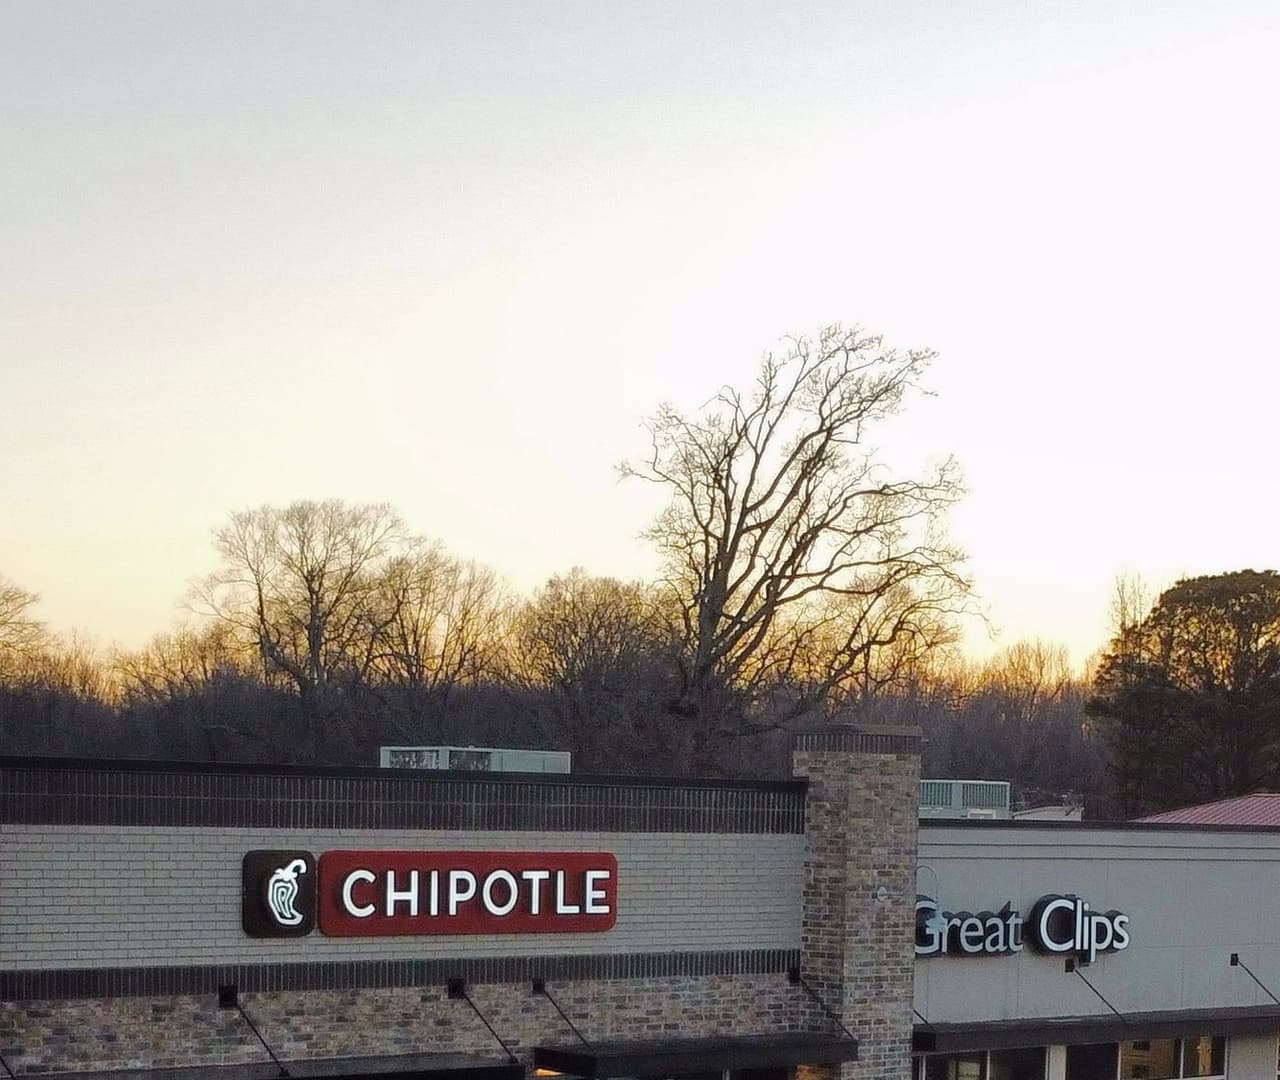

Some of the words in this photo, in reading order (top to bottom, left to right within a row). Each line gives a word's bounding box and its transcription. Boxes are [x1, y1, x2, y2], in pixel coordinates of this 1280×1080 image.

[342, 869, 611, 918] CHIPOTLE
[915, 899, 1024, 954] Great
[1039, 898, 1130, 963] Clips
